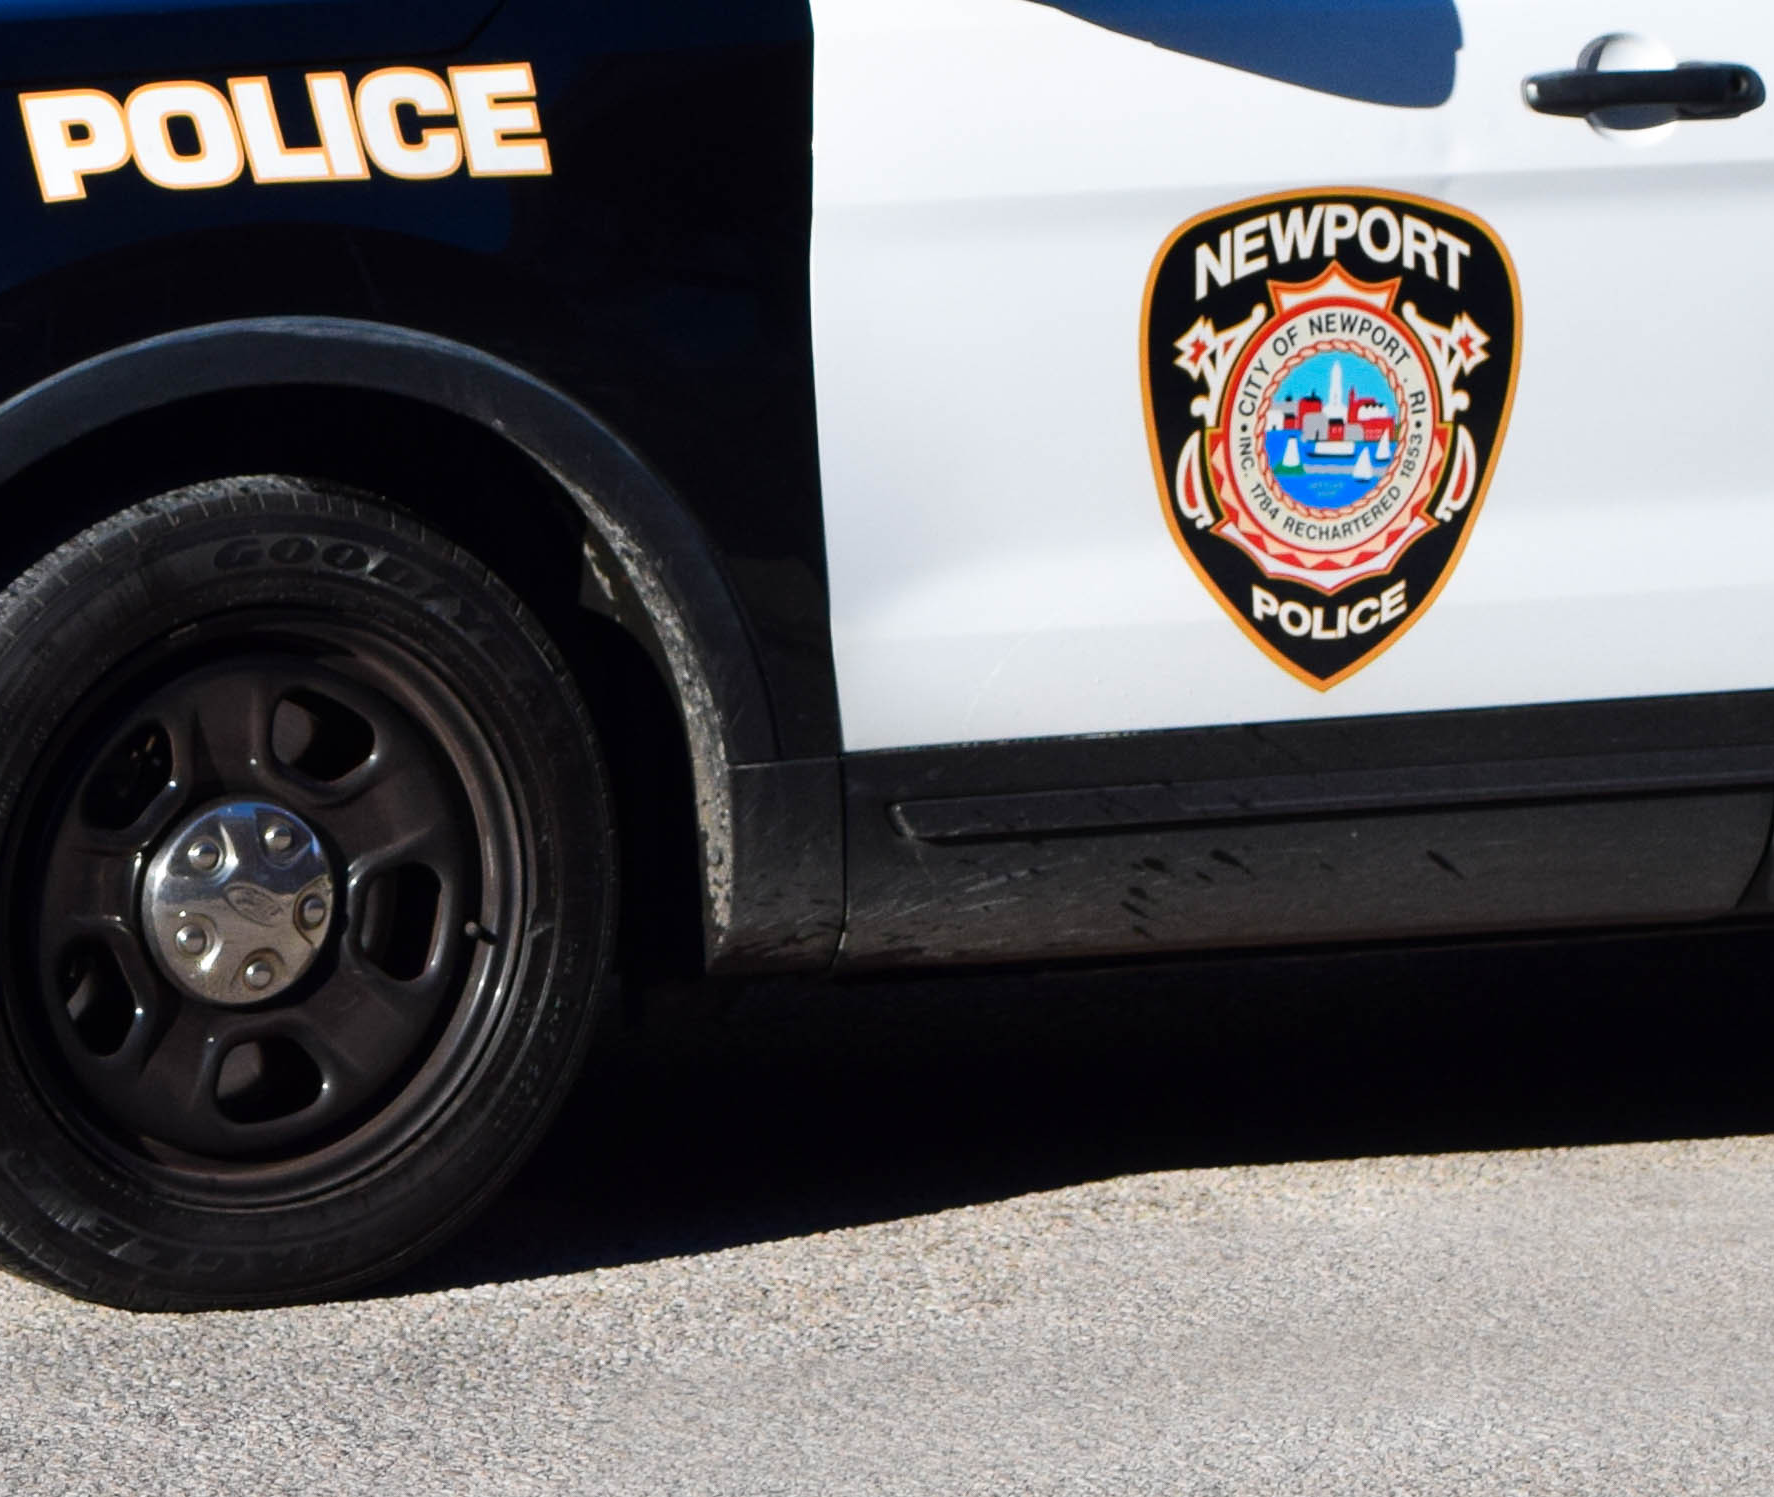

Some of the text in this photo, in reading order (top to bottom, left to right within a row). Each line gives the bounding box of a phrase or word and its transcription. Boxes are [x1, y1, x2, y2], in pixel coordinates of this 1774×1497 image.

[19, 62, 552, 203] POLICE
[1195, 203, 1471, 301] NEWPORT
[1238, 357, 1270, 417] CITY
[1272, 325, 1299, 357] OF
[1309, 312, 1411, 366] NEWPORT
[1250, 483, 1280, 521] 1784
[1282, 485, 1402, 541] RECHARTERED
[1400, 433, 1424, 481] 1853
[1251, 578, 1407, 640] POLICE
